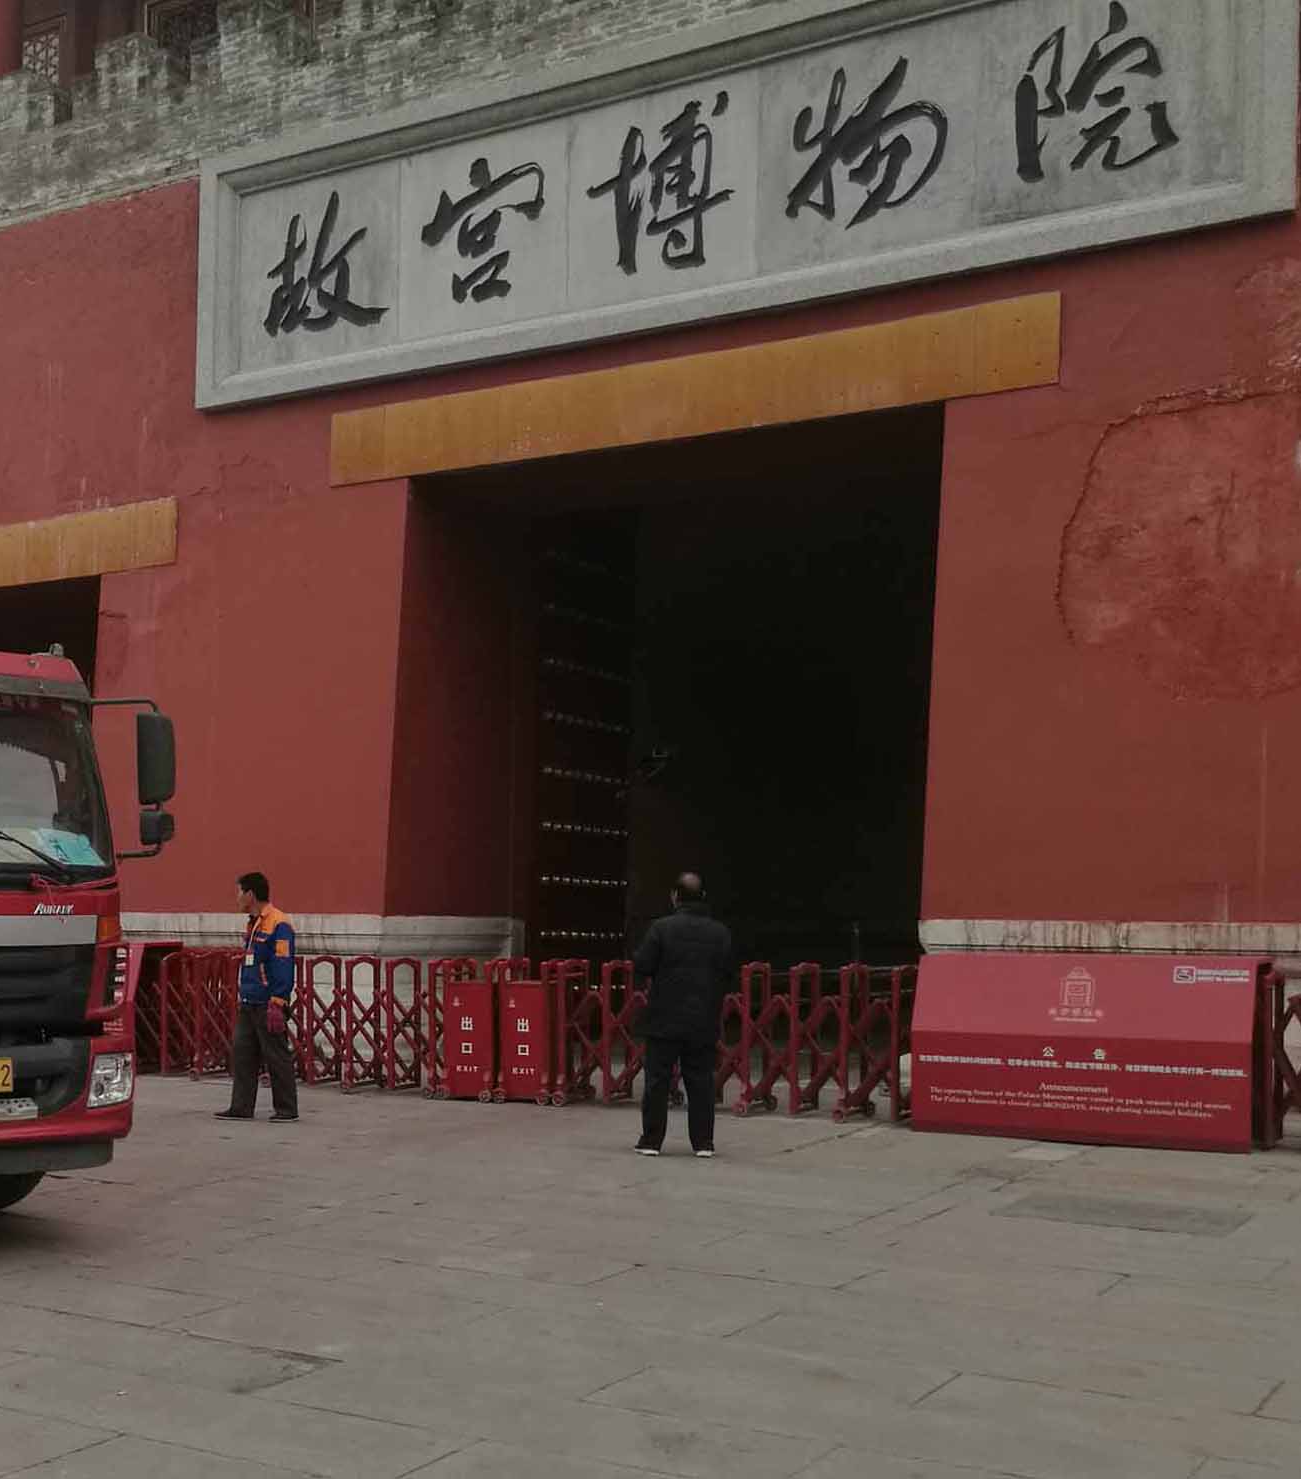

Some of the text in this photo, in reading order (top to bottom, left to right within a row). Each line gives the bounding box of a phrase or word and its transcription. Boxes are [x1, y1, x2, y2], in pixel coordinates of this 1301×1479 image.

[461, 1016, 473, 1054] 出口
[517, 1018, 530, 1056] 出口
[456, 1065, 479, 1073] EXIT
[512, 1067, 536, 1075] EXIT
